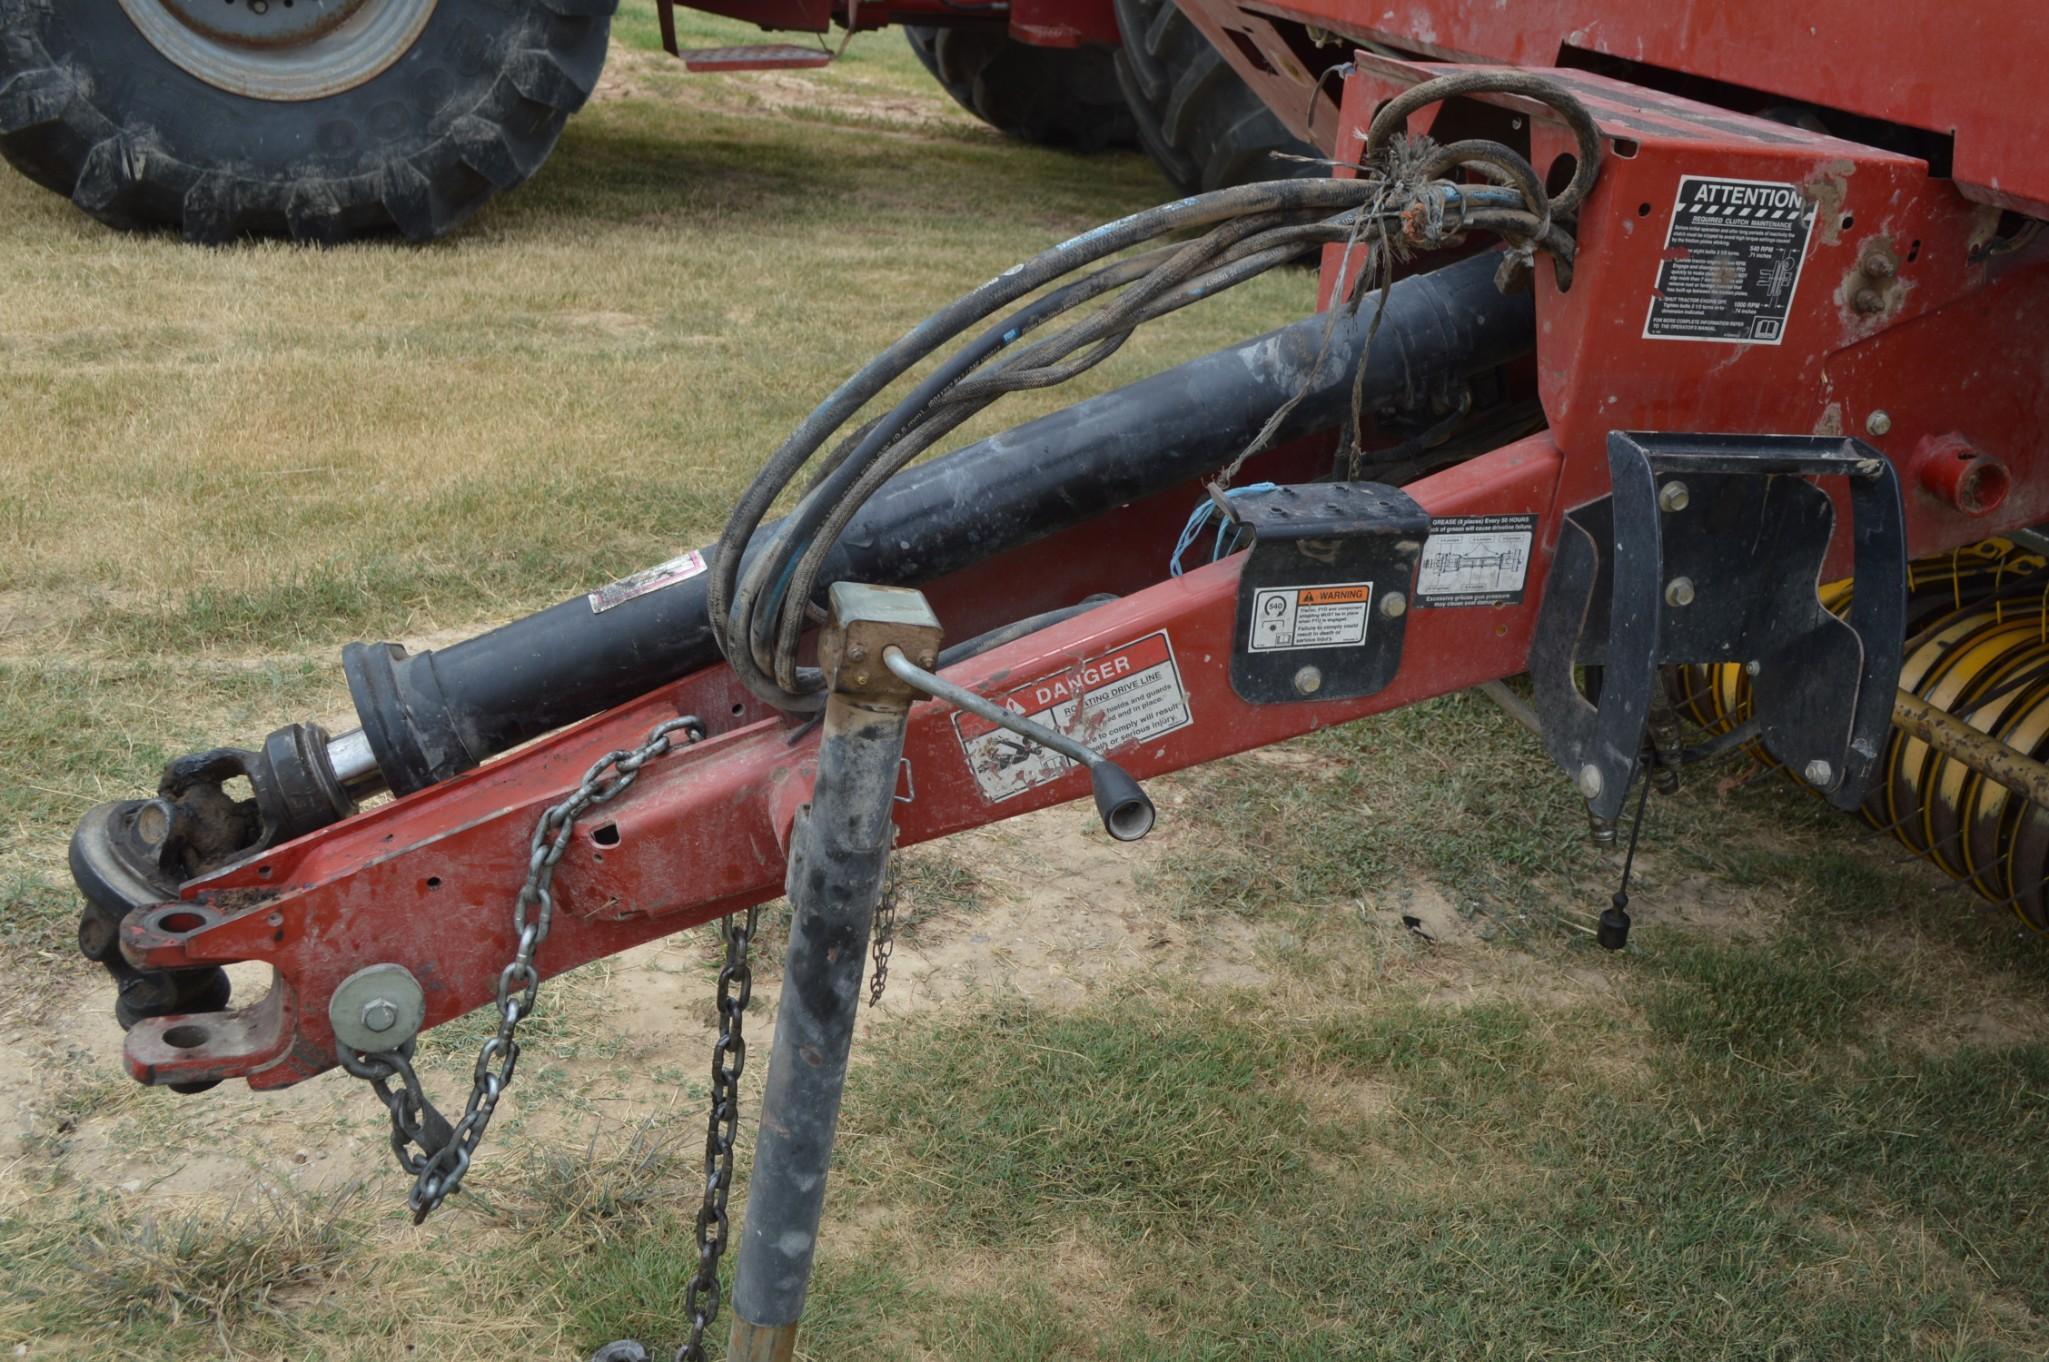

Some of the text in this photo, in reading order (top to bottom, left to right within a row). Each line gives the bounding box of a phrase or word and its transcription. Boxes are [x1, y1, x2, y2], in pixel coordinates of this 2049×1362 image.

[1694, 184, 1802, 208] ATTENTION
[1692, 216, 1723, 224] REQUIRED
[1751, 220, 1792, 229] MAINTENANCE
[1320, 590, 1362, 600] WARNING
[1036, 655, 1131, 705] DANGER
[1112, 679, 1139, 697] DRIVE
[1140, 670, 1162, 685] LINE
[1130, 692, 1146, 704] and
[1146, 683, 1172, 702] guards
[1098, 731, 1107, 739] to
[1109, 720, 1138, 737] comply
[1140, 712, 1154, 724] will
[1155, 703, 1179, 718] result
[1118, 708, 1132, 720] and
[1133, 704, 1141, 714] in
[1110, 737, 1118, 745] or
[1120, 726, 1151, 741] serious
